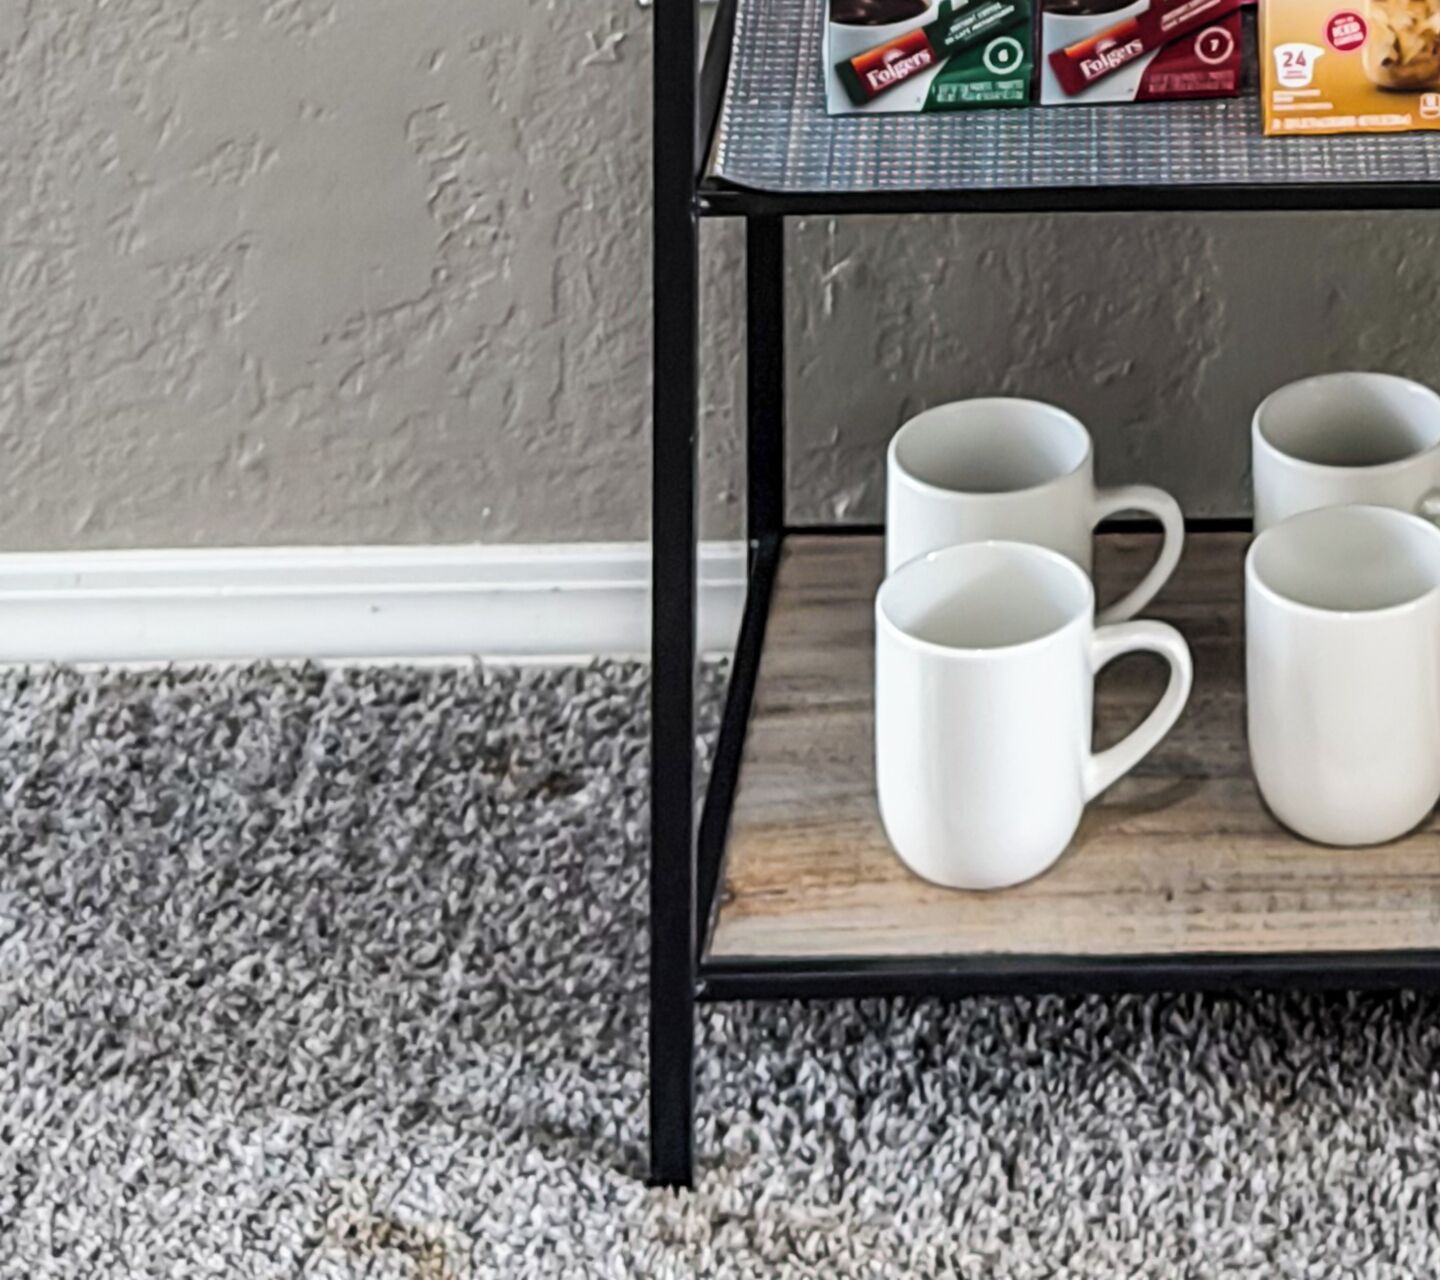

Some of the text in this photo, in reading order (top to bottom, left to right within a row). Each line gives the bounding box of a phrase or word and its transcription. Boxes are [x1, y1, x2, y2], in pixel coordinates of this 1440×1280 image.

[866, 49, 931, 90] Folgers
[1079, 39, 1144, 80] Folgers
[1282, 50, 1307, 68] 24
